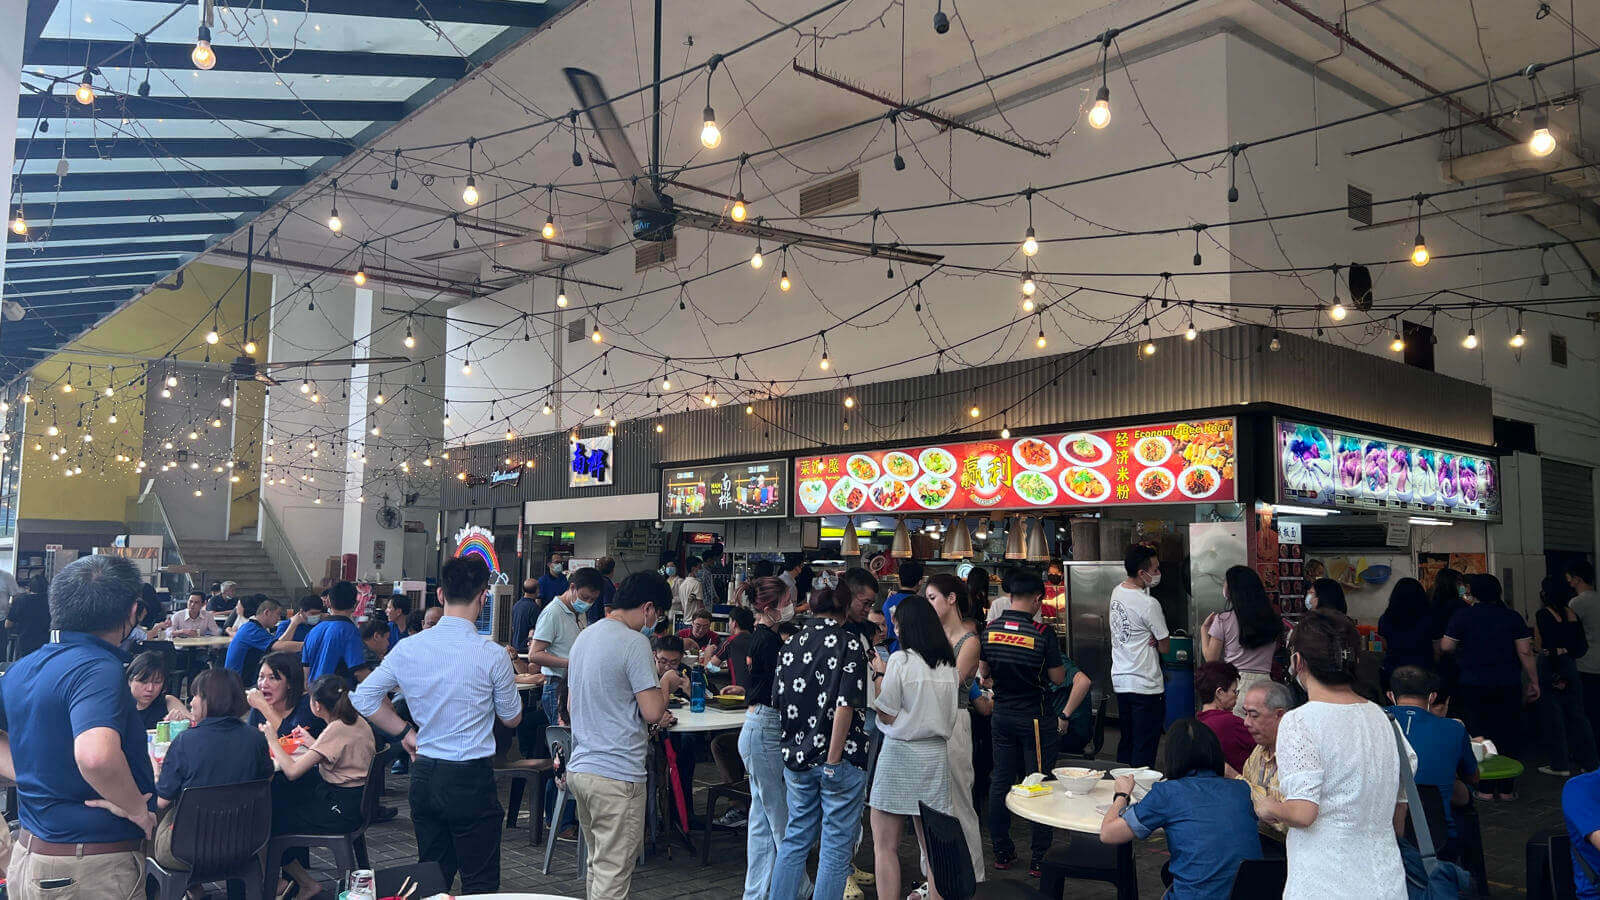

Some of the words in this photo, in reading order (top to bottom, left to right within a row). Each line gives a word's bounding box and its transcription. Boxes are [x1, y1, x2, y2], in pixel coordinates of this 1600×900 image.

[1134, 427, 1181, 438] Economic
[1183, 425, 1200, 435] Bee
[1204, 422, 1230, 432] Hoon
[1115, 432, 1130, 500] 经济米粉
[993, 633, 1028, 645] DHL
